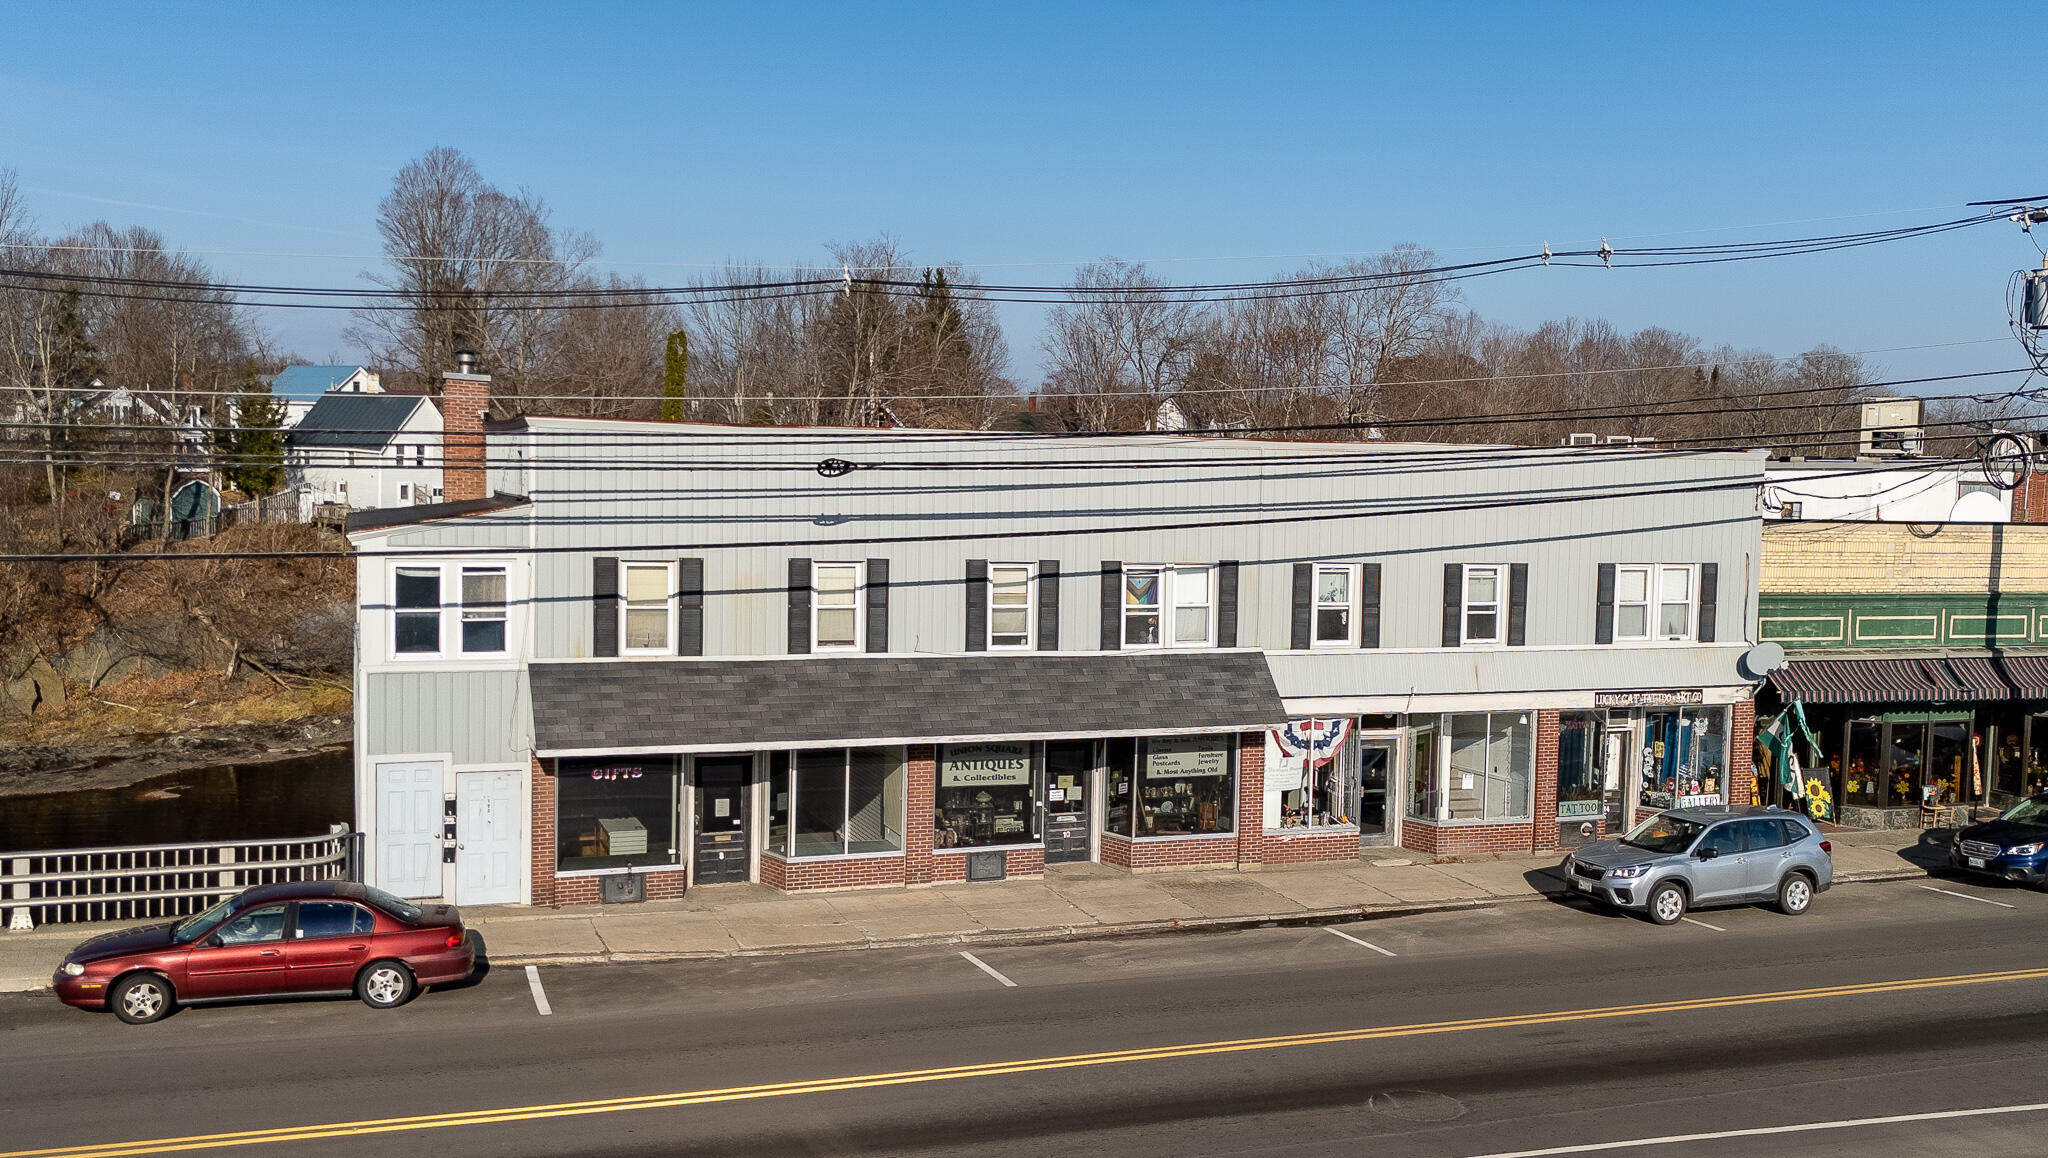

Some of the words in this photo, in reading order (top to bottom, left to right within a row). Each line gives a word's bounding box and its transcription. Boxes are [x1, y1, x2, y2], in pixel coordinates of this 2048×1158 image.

[1595, 694, 1620, 705] LUCKY
[1621, 693, 1640, 704] CAT
[1641, 692, 1672, 704] TATTOO
[1676, 692, 1692, 704] ART
[949, 745, 982, 756] UNION
[985, 744, 1025, 755] SQUARE
[949, 759, 1024, 772] ANTIQUES
[1180, 767, 1206, 775] Anything
[591, 767, 643, 780] GIFTS
[1560, 803, 1597, 814] TATTOO
[1062, 831, 1071, 839] 10
